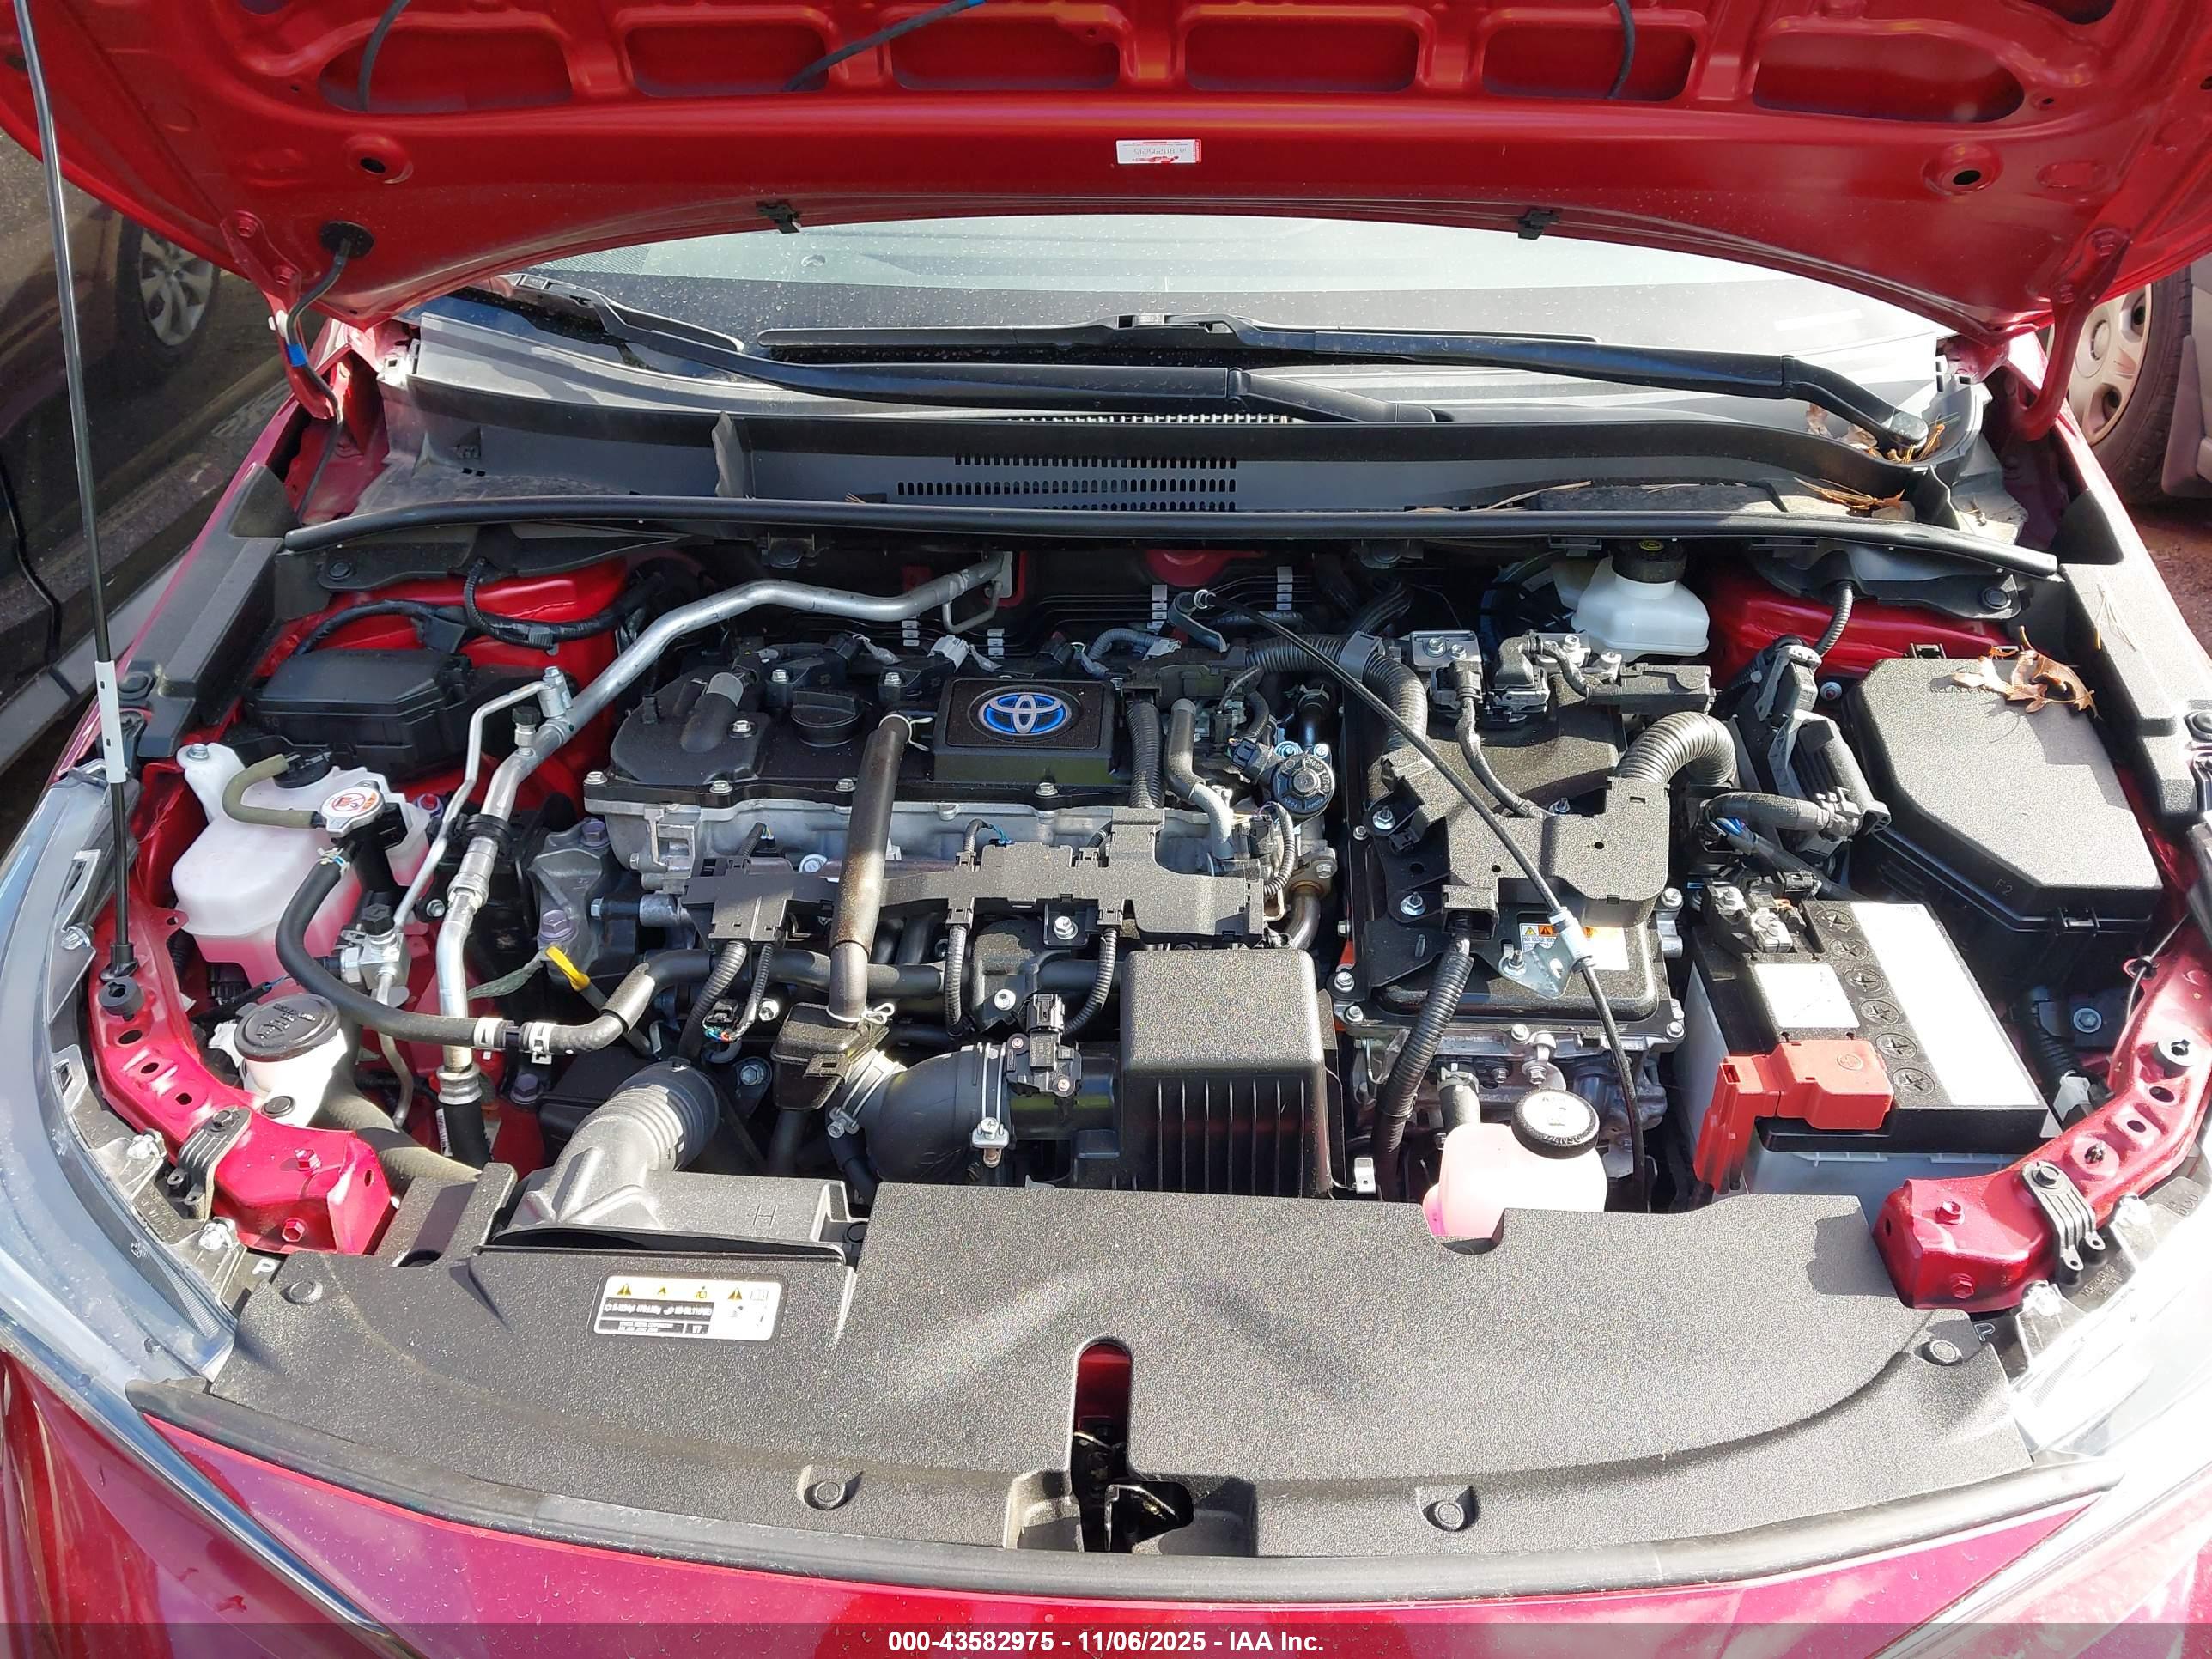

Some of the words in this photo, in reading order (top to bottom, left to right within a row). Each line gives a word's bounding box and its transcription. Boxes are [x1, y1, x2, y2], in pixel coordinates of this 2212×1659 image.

[1994, 878, 2014, 894] F2
[752, 1203, 777, 1226] H
[252, 1258, 276, 1275] P
[1973, 1322, 1996, 1342] P
